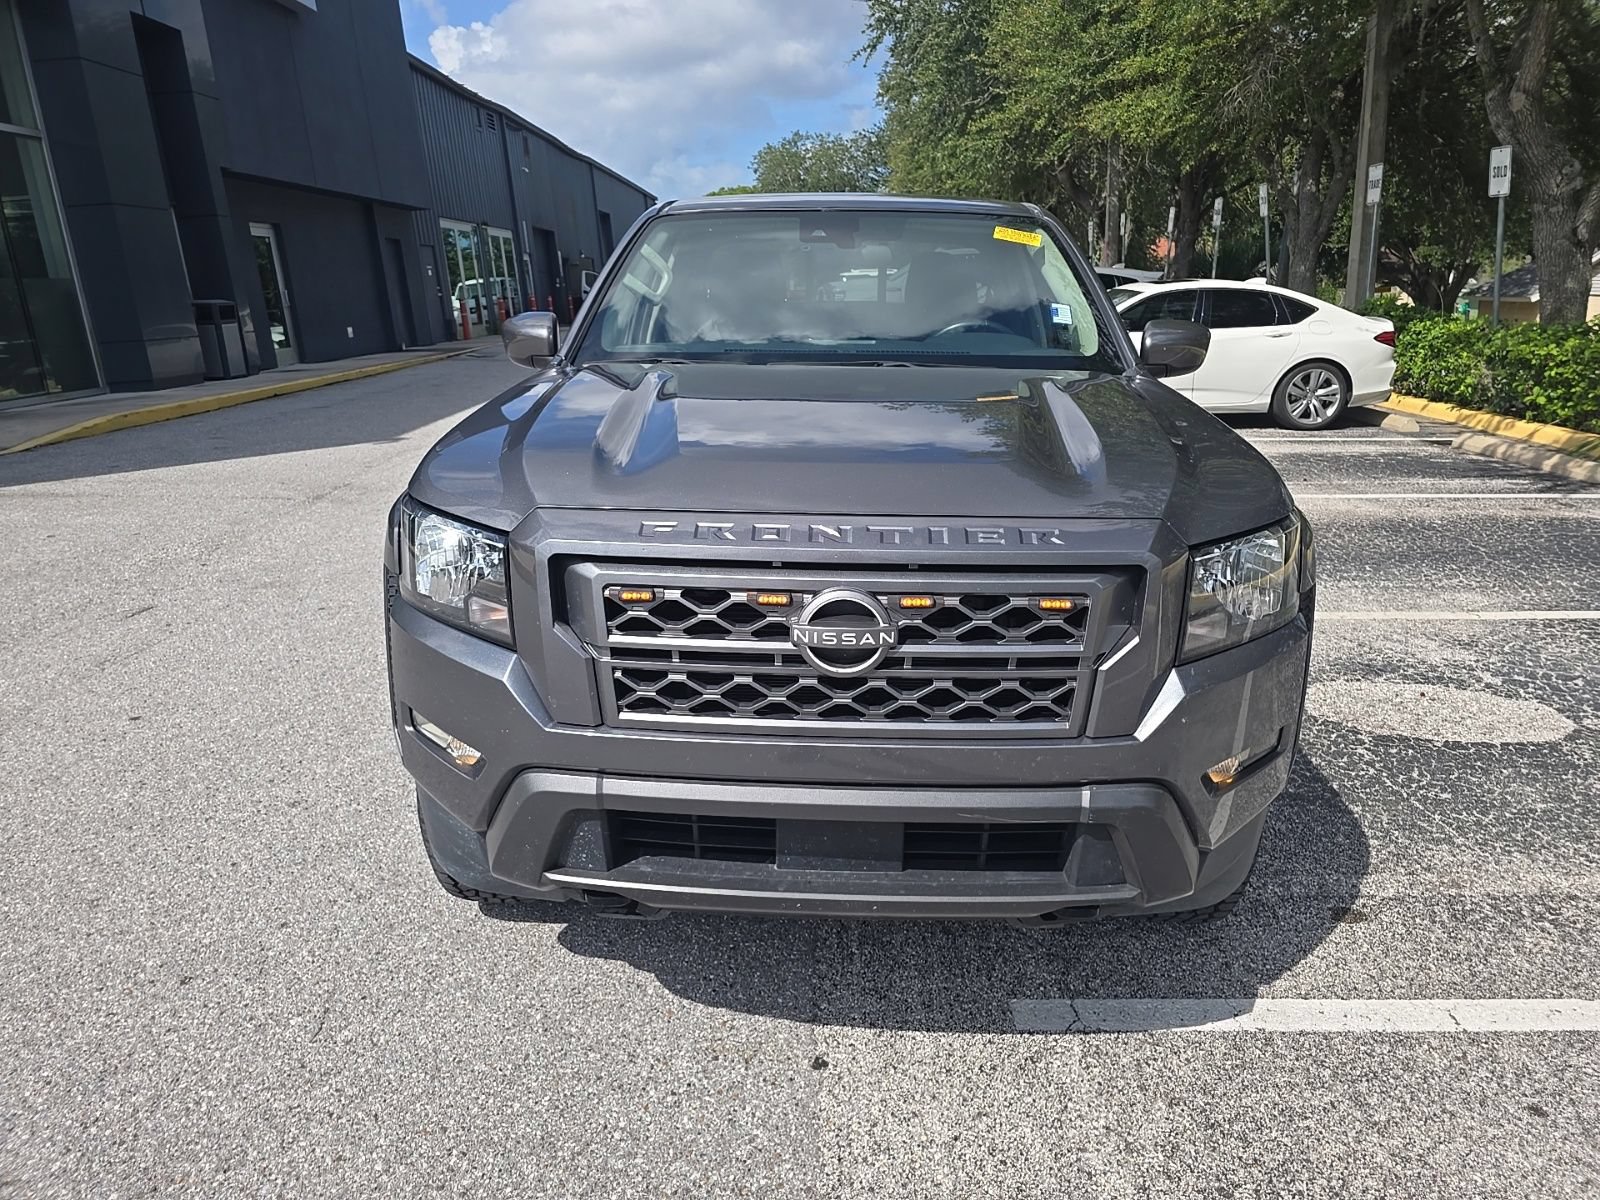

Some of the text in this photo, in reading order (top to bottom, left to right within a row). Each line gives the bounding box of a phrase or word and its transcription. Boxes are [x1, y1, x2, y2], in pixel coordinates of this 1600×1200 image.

[1492, 165, 1508, 178] SOLD
[639, 521, 1065, 546] FRONTIER
[793, 628, 896, 646] NISSAN
